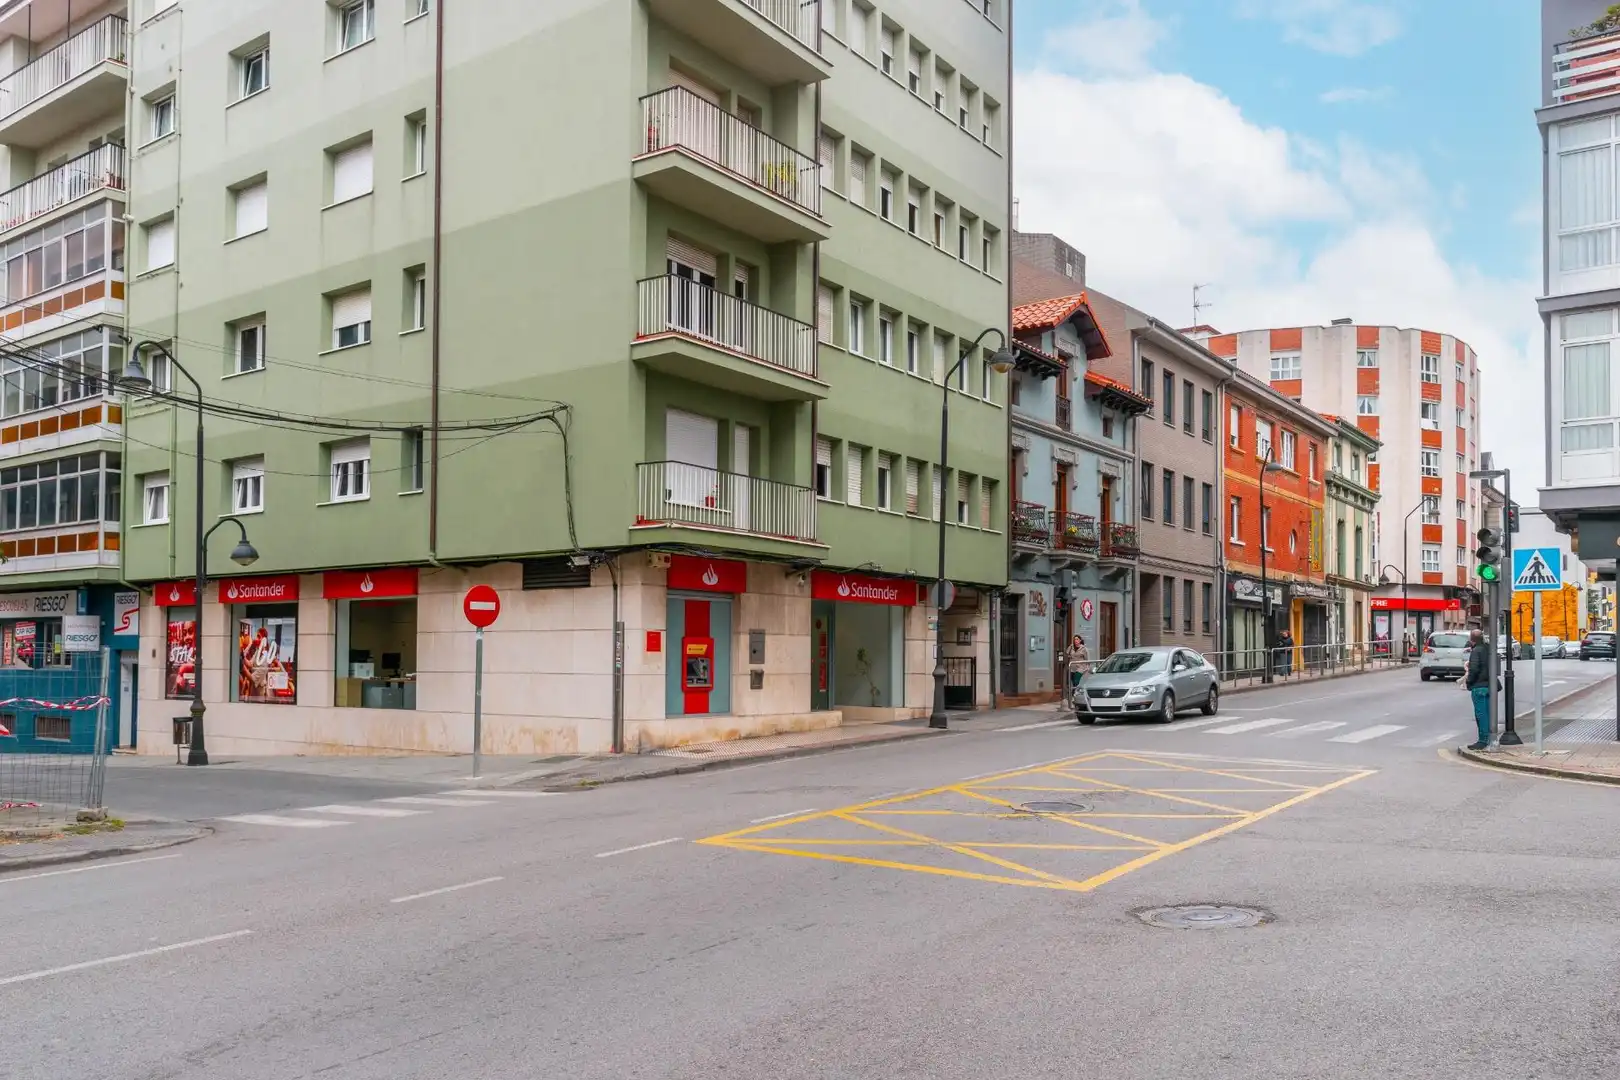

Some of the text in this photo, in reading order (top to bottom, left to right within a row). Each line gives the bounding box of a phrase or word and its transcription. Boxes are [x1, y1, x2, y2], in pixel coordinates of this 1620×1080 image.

[239, 583, 285, 598] Santander
[851, 582, 898, 600] Santander
[34, 594, 69, 612] RIESGO
[66, 634, 98, 642] RIESGO
